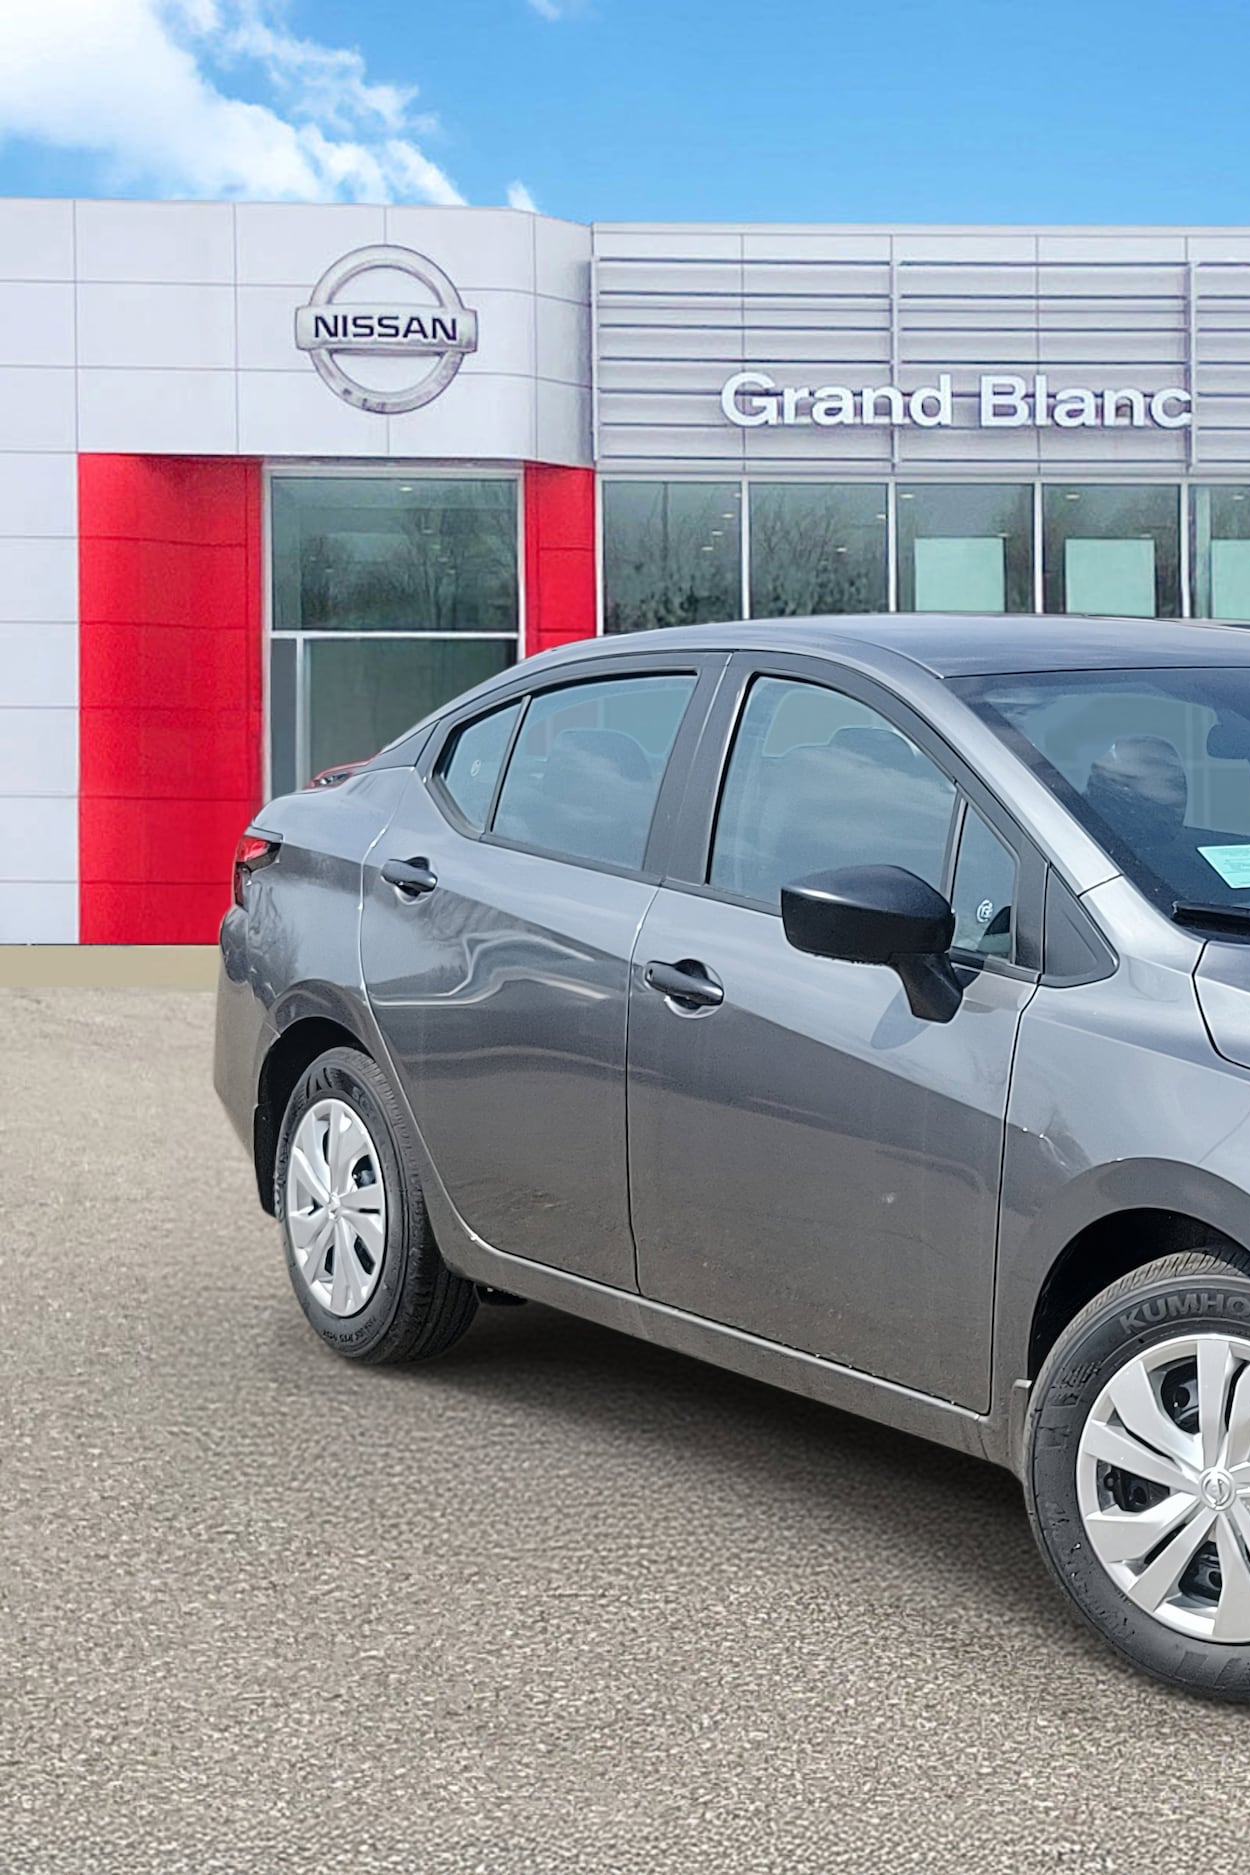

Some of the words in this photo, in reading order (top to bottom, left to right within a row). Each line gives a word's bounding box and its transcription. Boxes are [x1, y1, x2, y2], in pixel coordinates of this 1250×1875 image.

[313, 314, 458, 341] NISSAN
[719, 370, 951, 428] Grand
[979, 373, 1193, 429] Blanc
